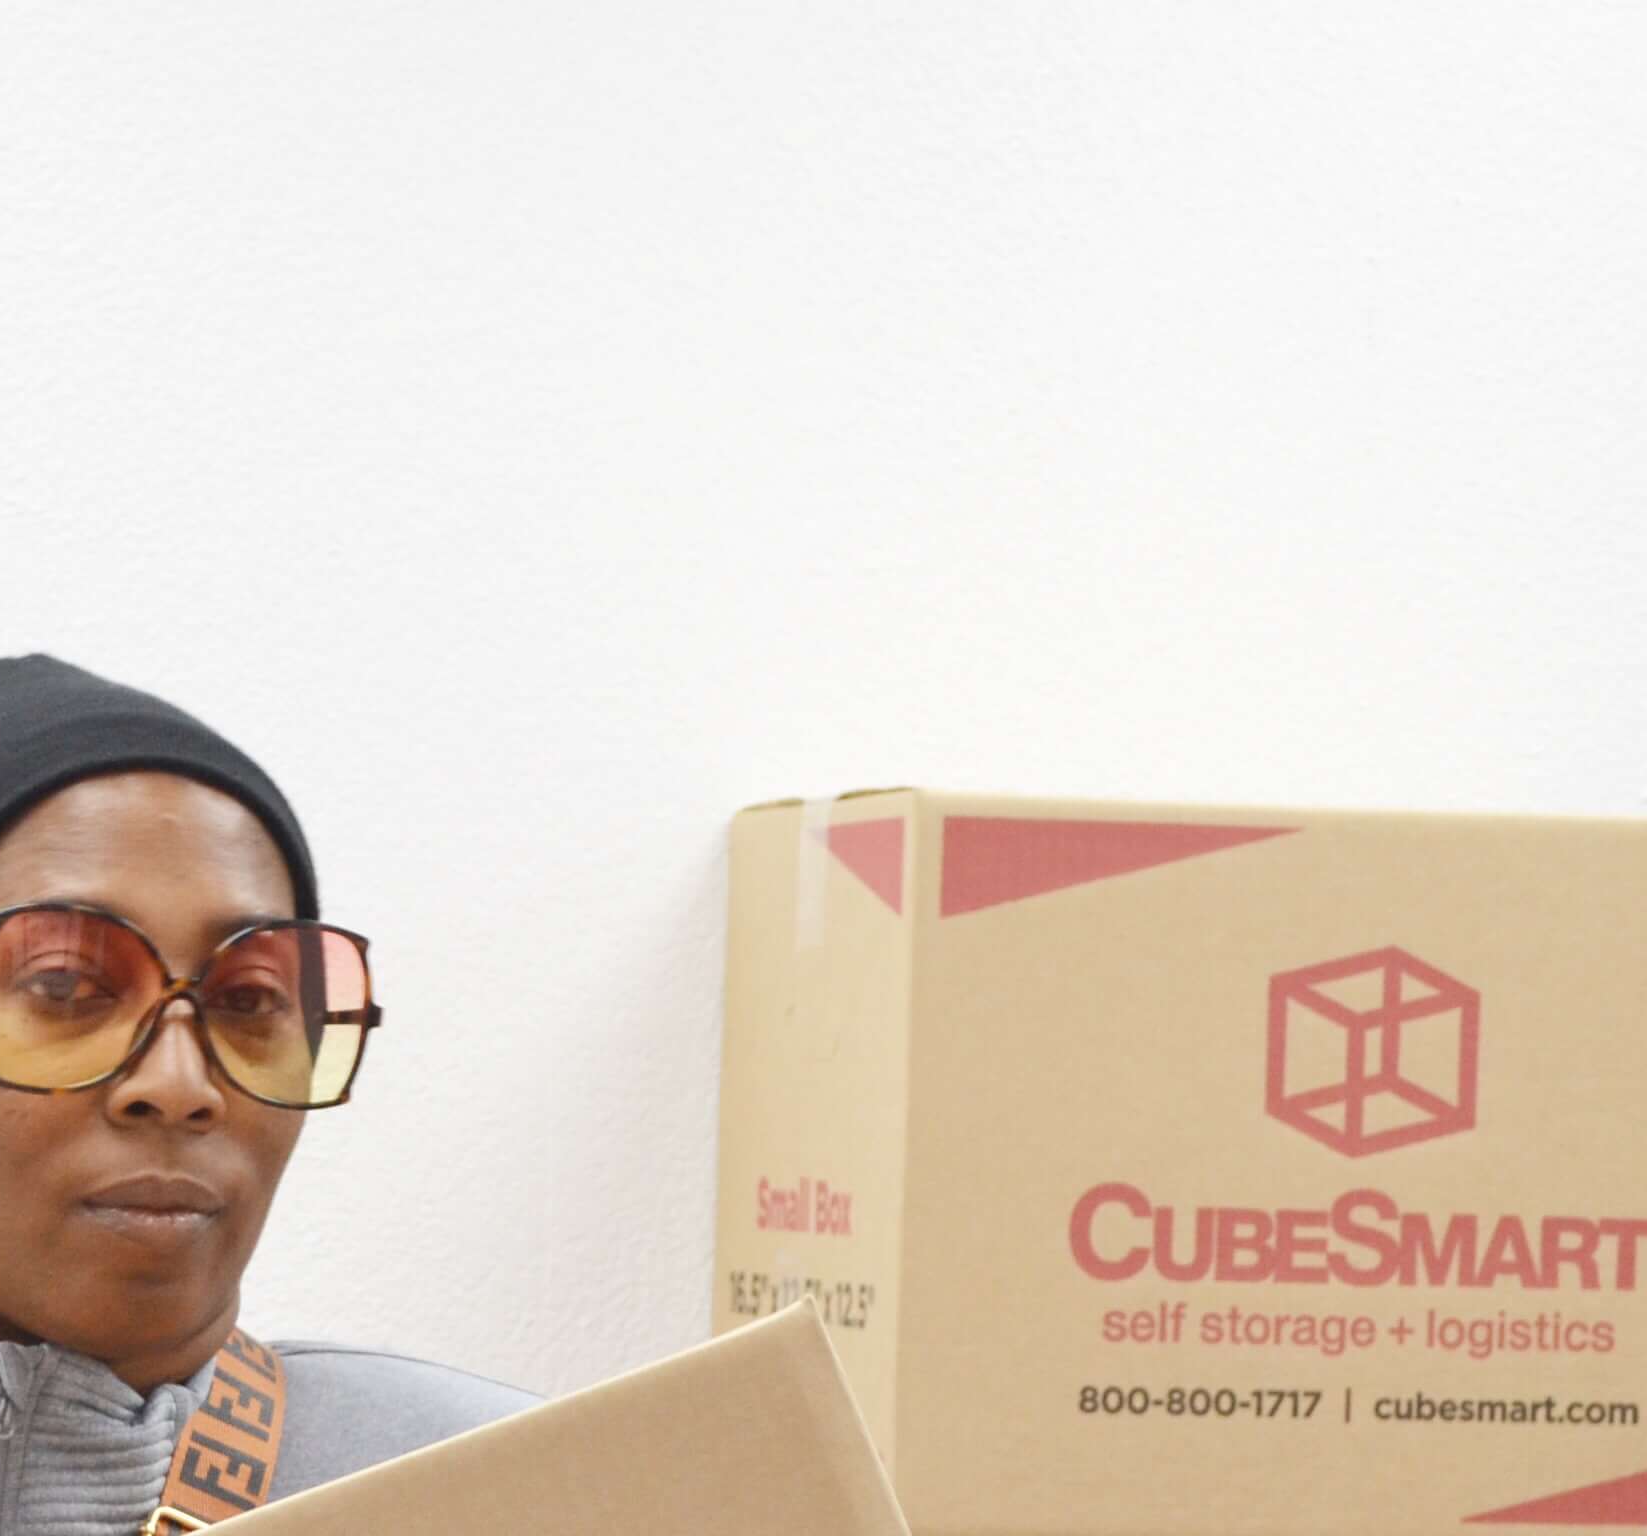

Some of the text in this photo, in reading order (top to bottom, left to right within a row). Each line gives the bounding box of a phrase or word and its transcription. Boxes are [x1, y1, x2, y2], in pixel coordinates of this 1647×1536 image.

[815, 1179, 852, 1236] Box
[1103, 1303, 1185, 1344] self
[1200, 1307, 1377, 1360] storage
[1426, 1312, 1617, 1361] logistics
[1078, 1385, 1322, 1418] 800-800-1717
[1374, 1390, 1639, 1426] cubesmart.com
